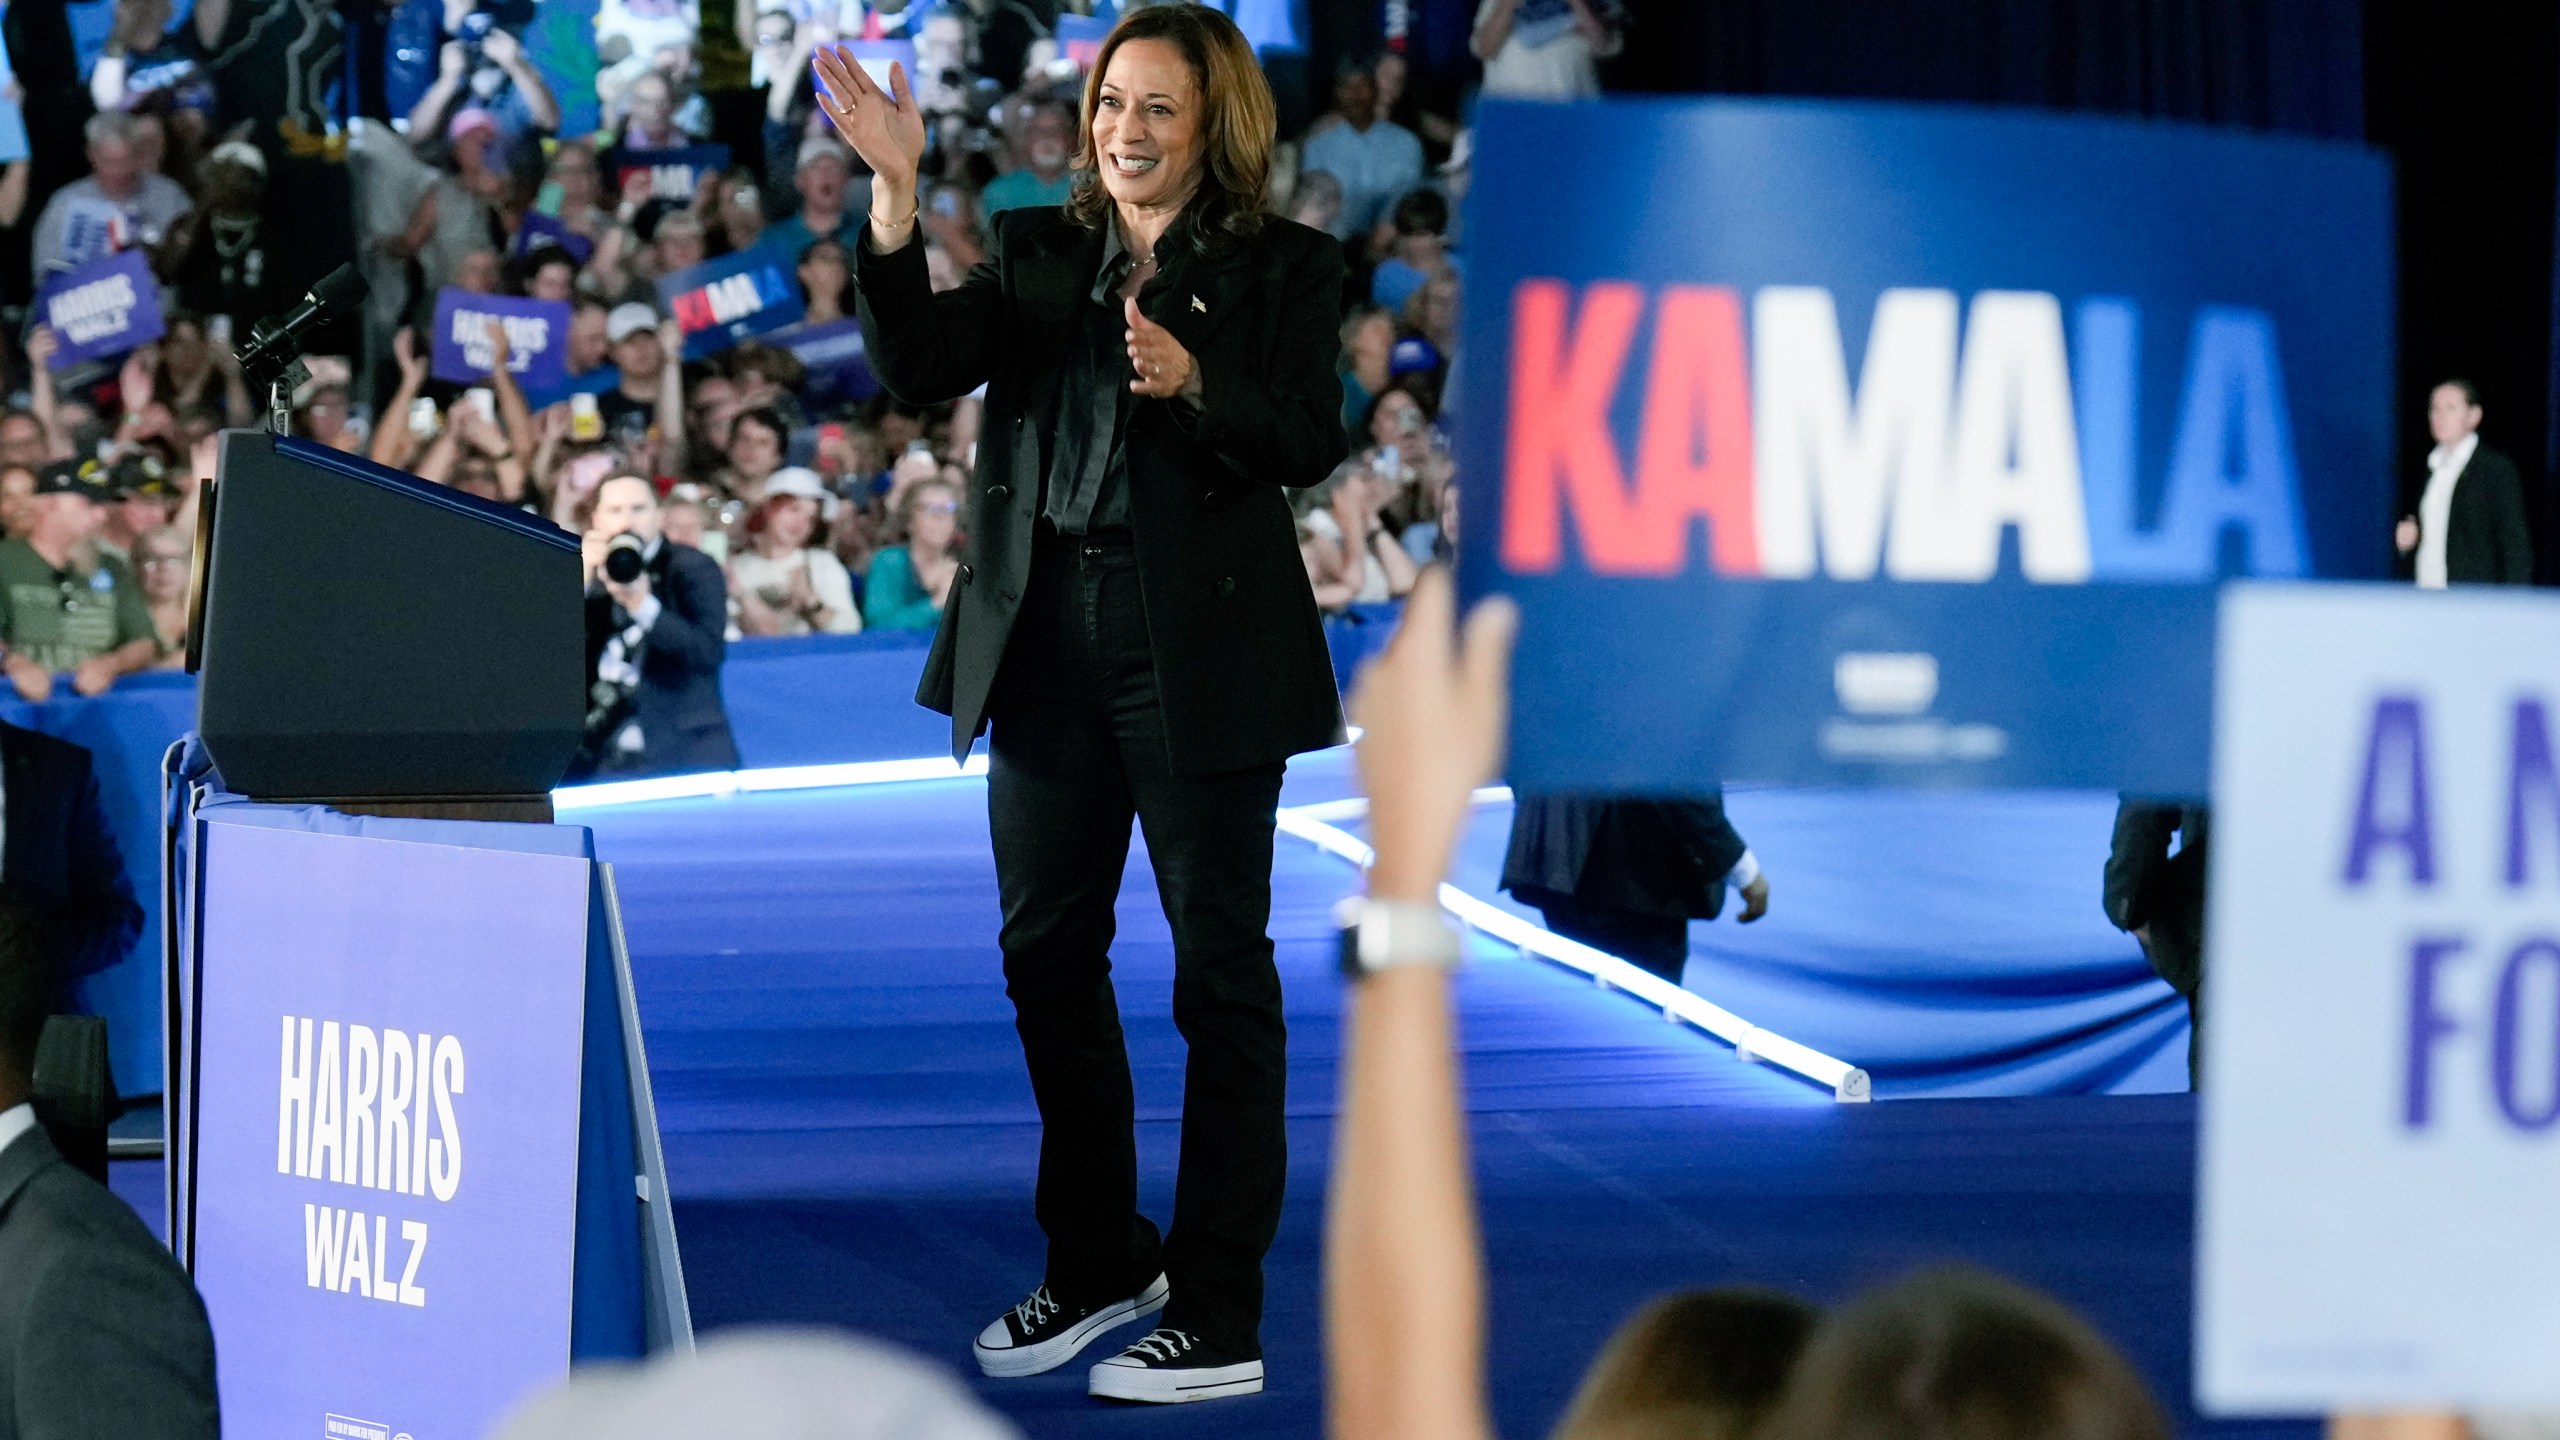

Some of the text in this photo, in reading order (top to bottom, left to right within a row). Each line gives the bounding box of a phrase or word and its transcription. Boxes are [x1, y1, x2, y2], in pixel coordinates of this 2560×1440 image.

[48, 273, 136, 328] HARRIS
[1500, 277, 2314, 583] KAMALA
[2340, 695, 2436, 887] A
[278, 1015, 464, 1202] HARRIS
[305, 1203, 428, 1307] WALZ
